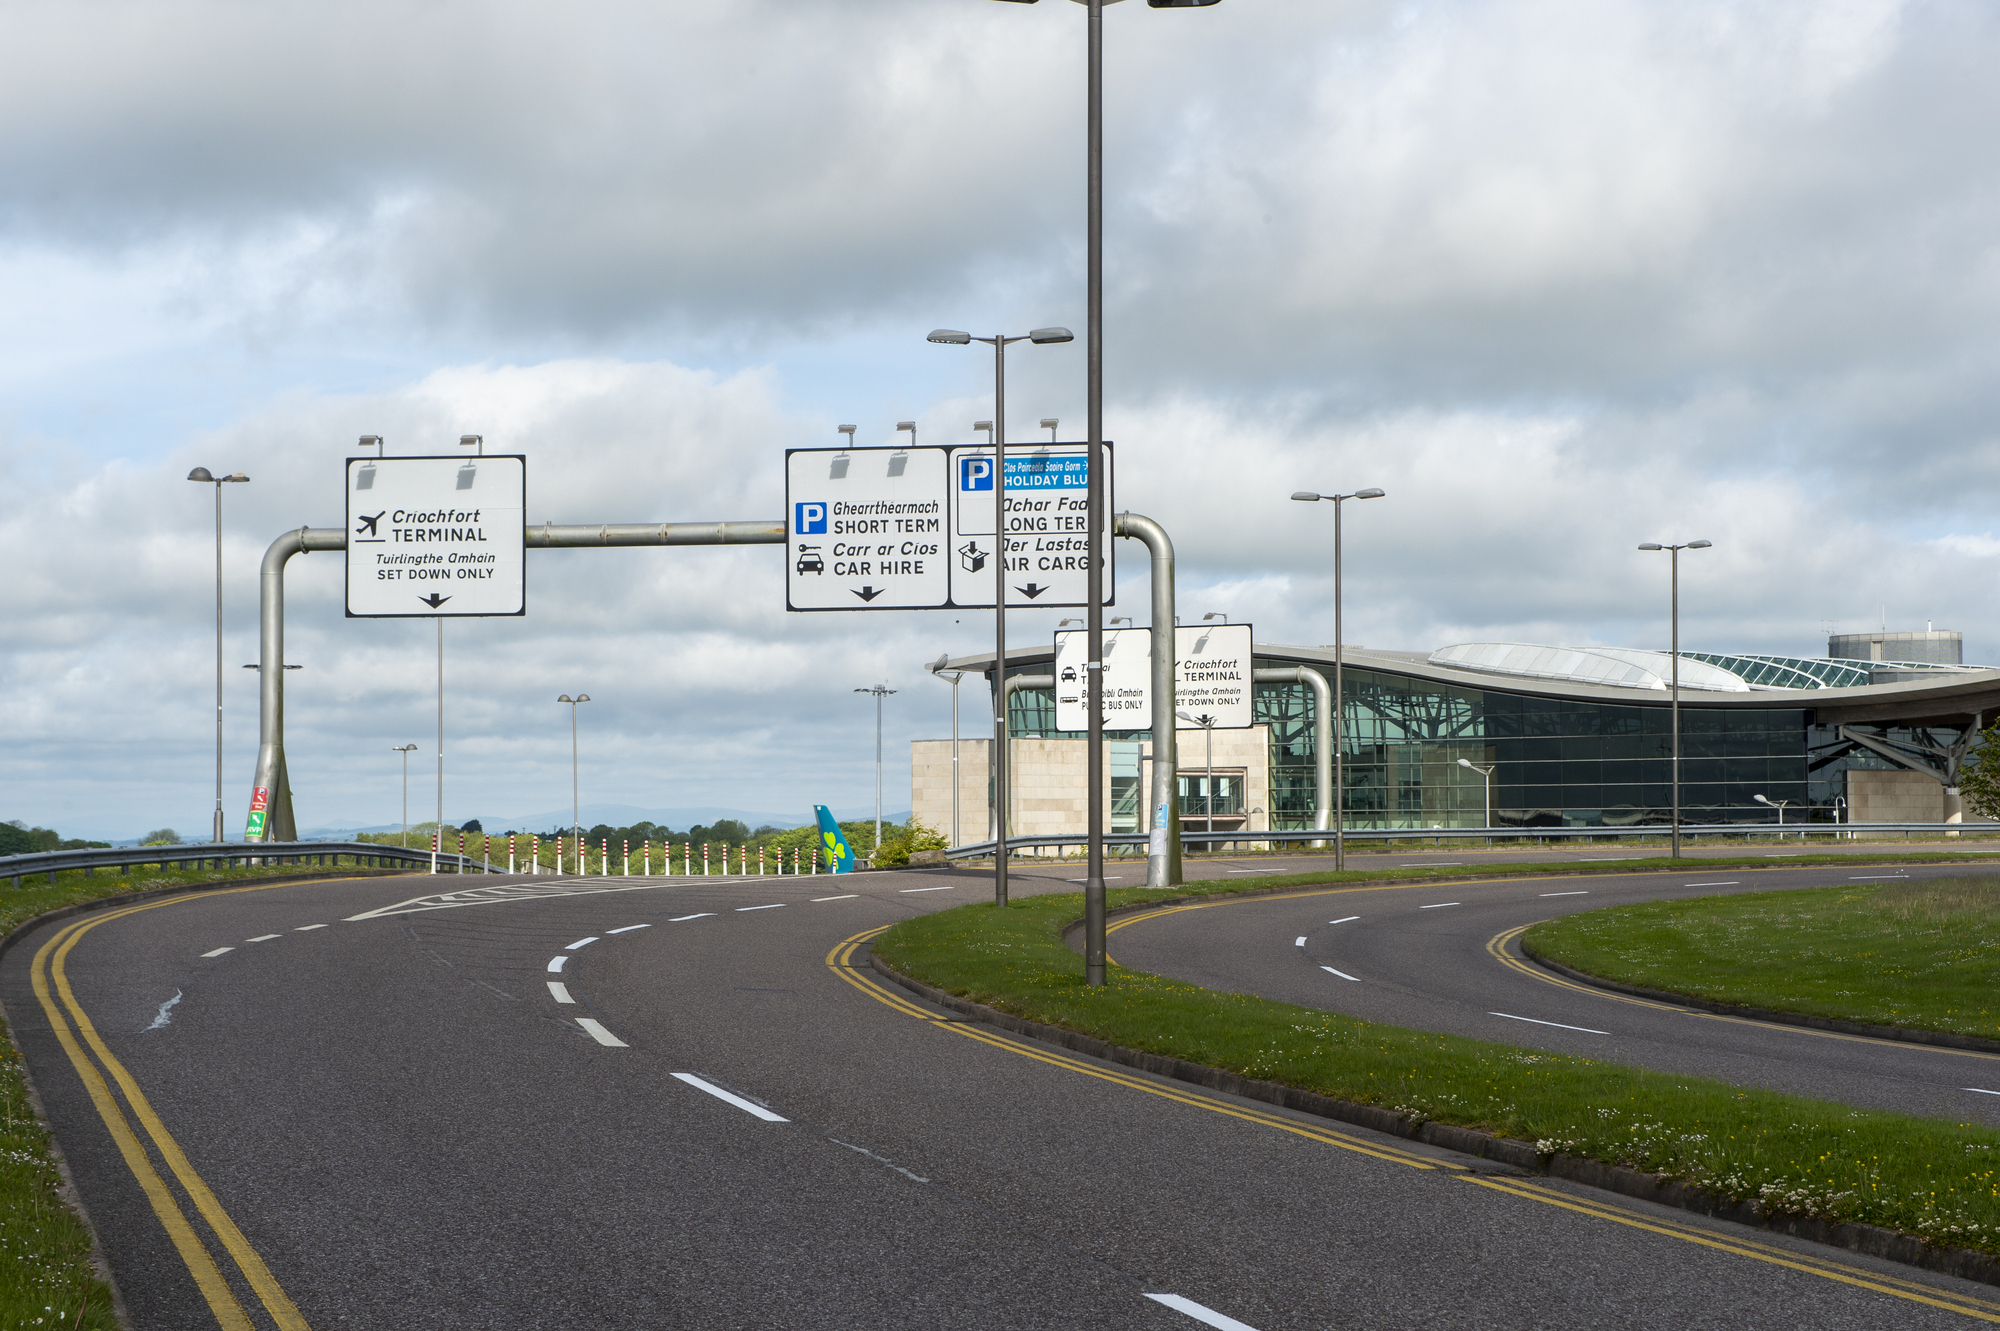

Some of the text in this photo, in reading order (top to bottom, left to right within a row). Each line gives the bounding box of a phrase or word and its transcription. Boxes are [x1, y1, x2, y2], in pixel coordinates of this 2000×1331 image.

[1045, 461, 1063, 472] Saoire
[1065, 461, 1081, 471] Gorm
[968, 461, 990, 489] P
[1004, 475, 1059, 486] HOLIDAY
[834, 500, 939, 515] Ghearrthéarmach
[392, 509, 480, 524] Críochfort
[802, 504, 824, 532] P
[834, 519, 939, 534] SHORT TERM
[392, 528, 487, 542] TERMINAL
[833, 541, 938, 556] Carr ar Cíos
[376, 552, 495, 566] Tuirlingthe Amháin
[1038, 556, 1105, 570] CARG
[377, 568, 494, 580] SET DOWN ONLY
[834, 561, 924, 576] CAR HIRE
[1184, 671, 1242, 681] TERMINAL
[1109, 700, 1122, 710] BUS
[1125, 700, 1143, 709] ONLY
